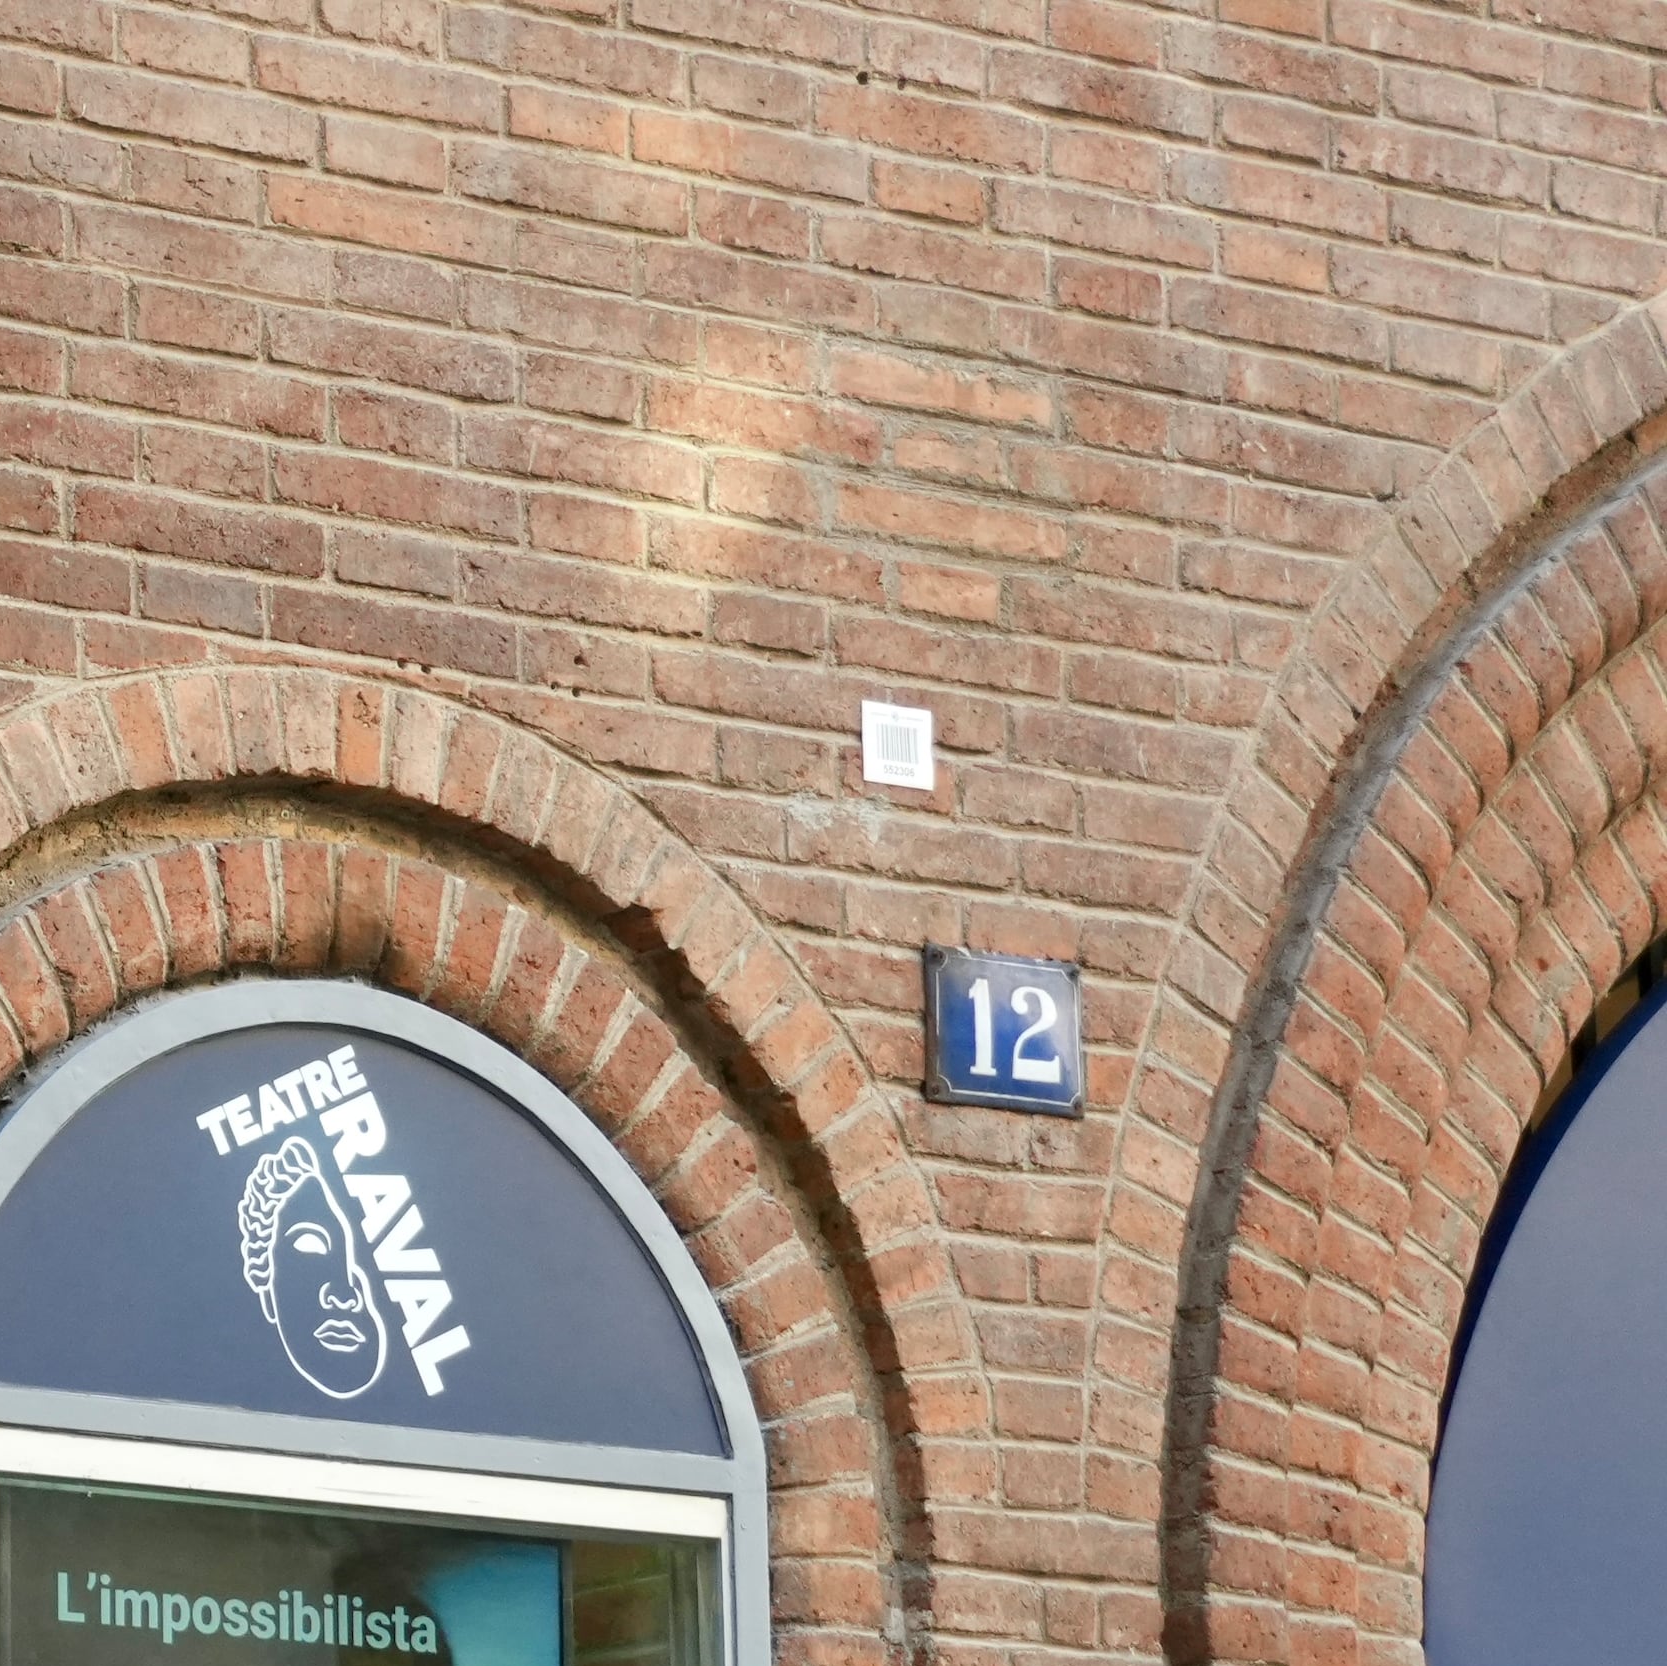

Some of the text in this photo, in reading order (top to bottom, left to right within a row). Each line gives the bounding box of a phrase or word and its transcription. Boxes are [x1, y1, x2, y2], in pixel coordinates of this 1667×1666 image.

[968, 978, 1061, 1085] 12
[195, 1043, 368, 1156] TEATRE
[318, 1090, 472, 1397] RAVAL
[56, 1570, 438, 1655] L'impossibilista
